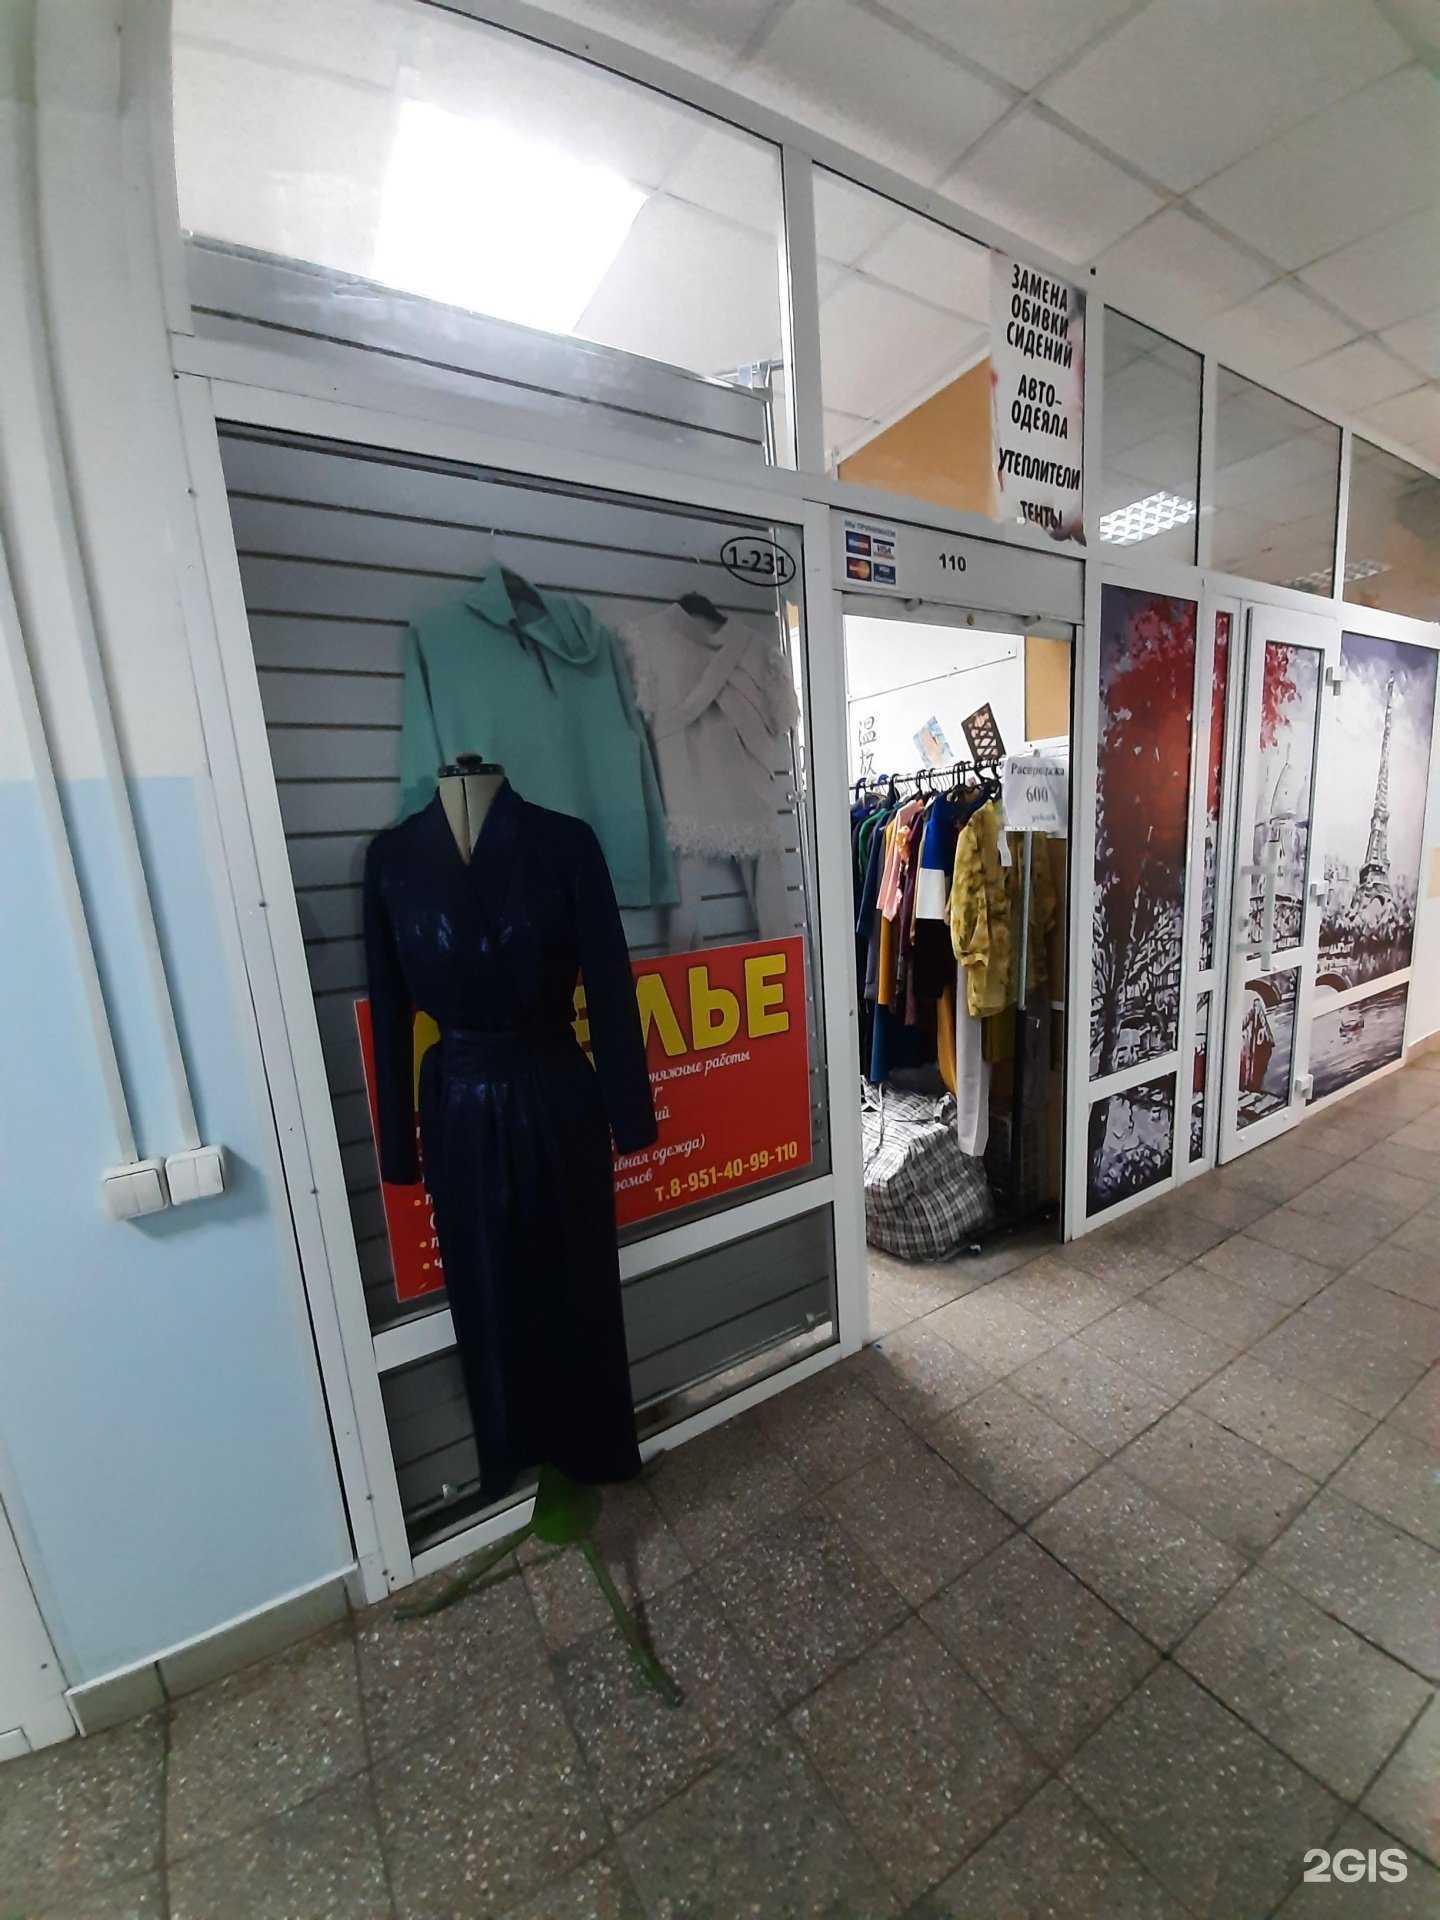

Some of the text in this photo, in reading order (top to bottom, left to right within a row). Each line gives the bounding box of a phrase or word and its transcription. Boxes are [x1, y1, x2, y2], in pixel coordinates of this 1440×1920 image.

[1011, 263, 1068, 313] ЗАМЕНА
[1011, 294, 1070, 339] ОБИВКИ
[1006, 321, 1074, 369] СИДЕНИЙ
[1017, 374, 1063, 408] АВТО-
[1011, 400, 1068, 440] ОДЕЯЛА
[998, 447, 1081, 491] УТЕПЛИТЕЛИ
[1019, 500, 1064, 530] ТЕНТЫ
[728, 546, 788, 578] 1-231
[938, 553, 967, 572] 110
[1026, 785, 1049, 803] 600
[648, 1050, 751, 1083] няжные работы
[652, 1133, 706, 1166] одежда)
